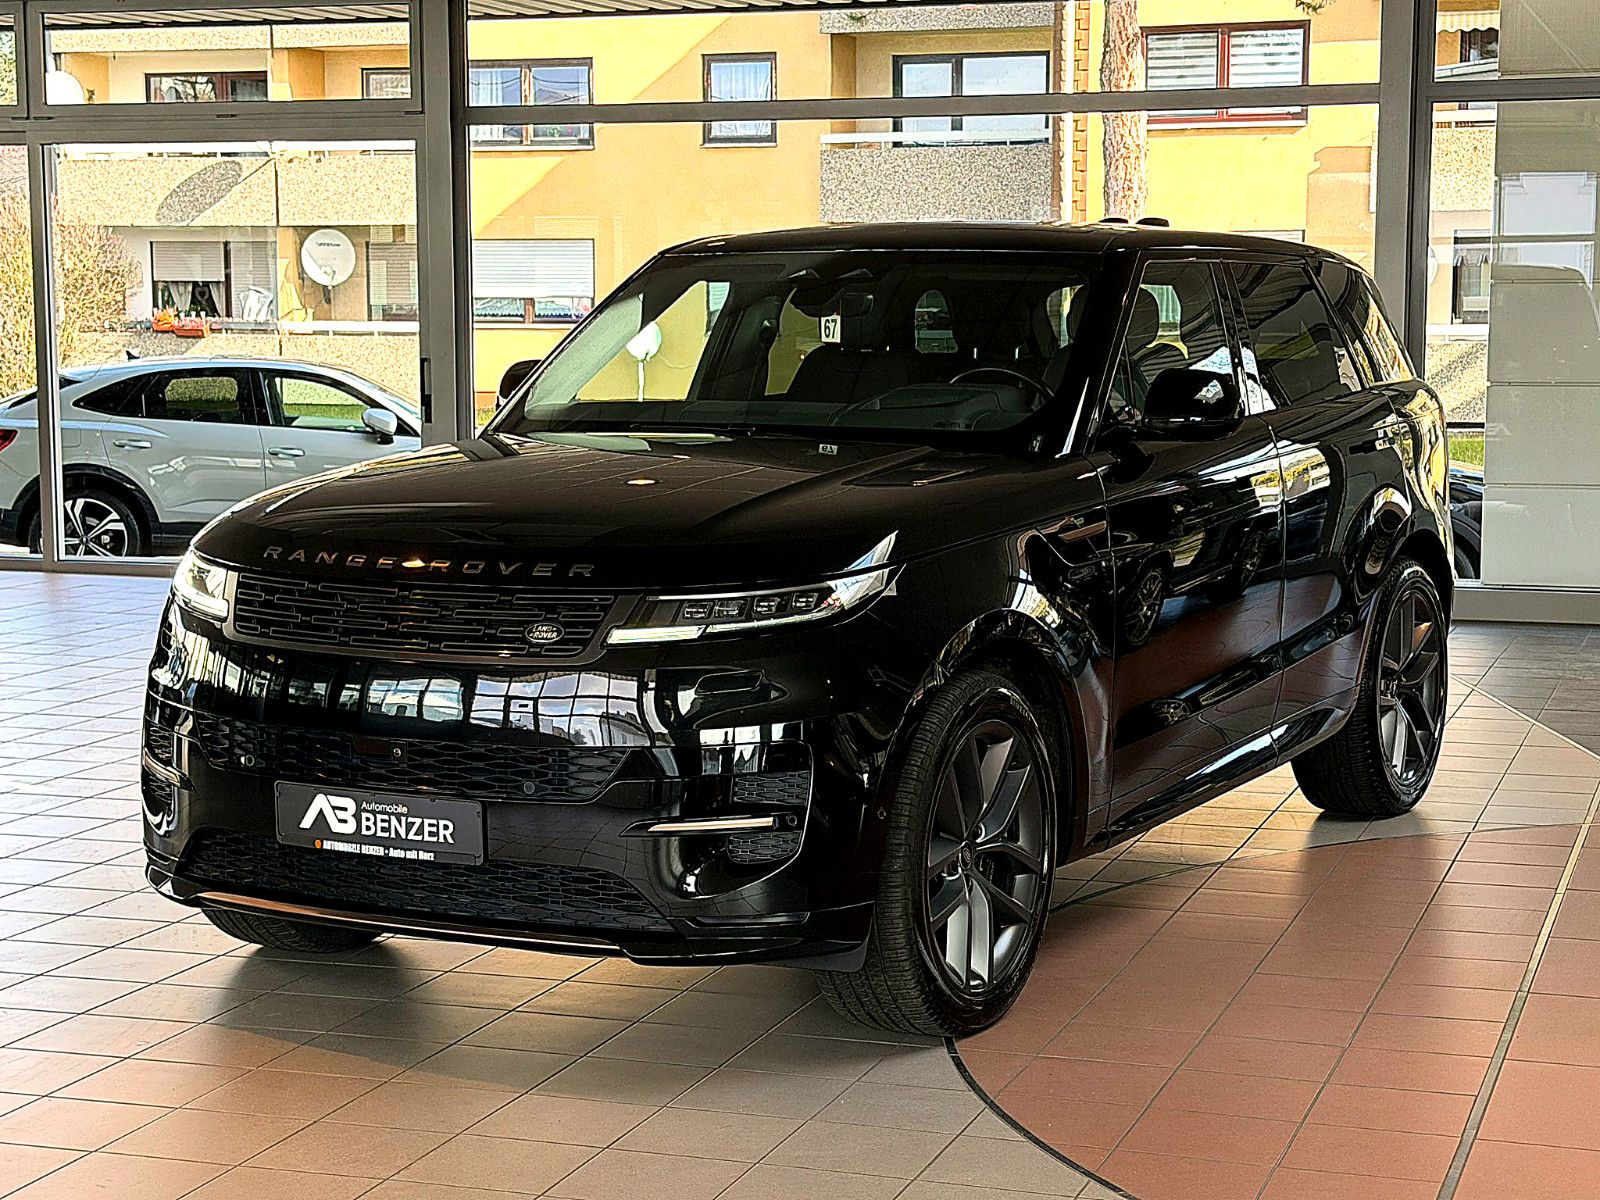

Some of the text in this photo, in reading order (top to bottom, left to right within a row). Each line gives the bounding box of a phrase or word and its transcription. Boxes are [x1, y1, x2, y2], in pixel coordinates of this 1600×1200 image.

[823, 318, 838, 339] 67
[263, 546, 595, 577] RANGE ROVER
[299, 793, 357, 835] AB
[361, 801, 408, 814] Automobile
[361, 812, 455, 844] BENZER
